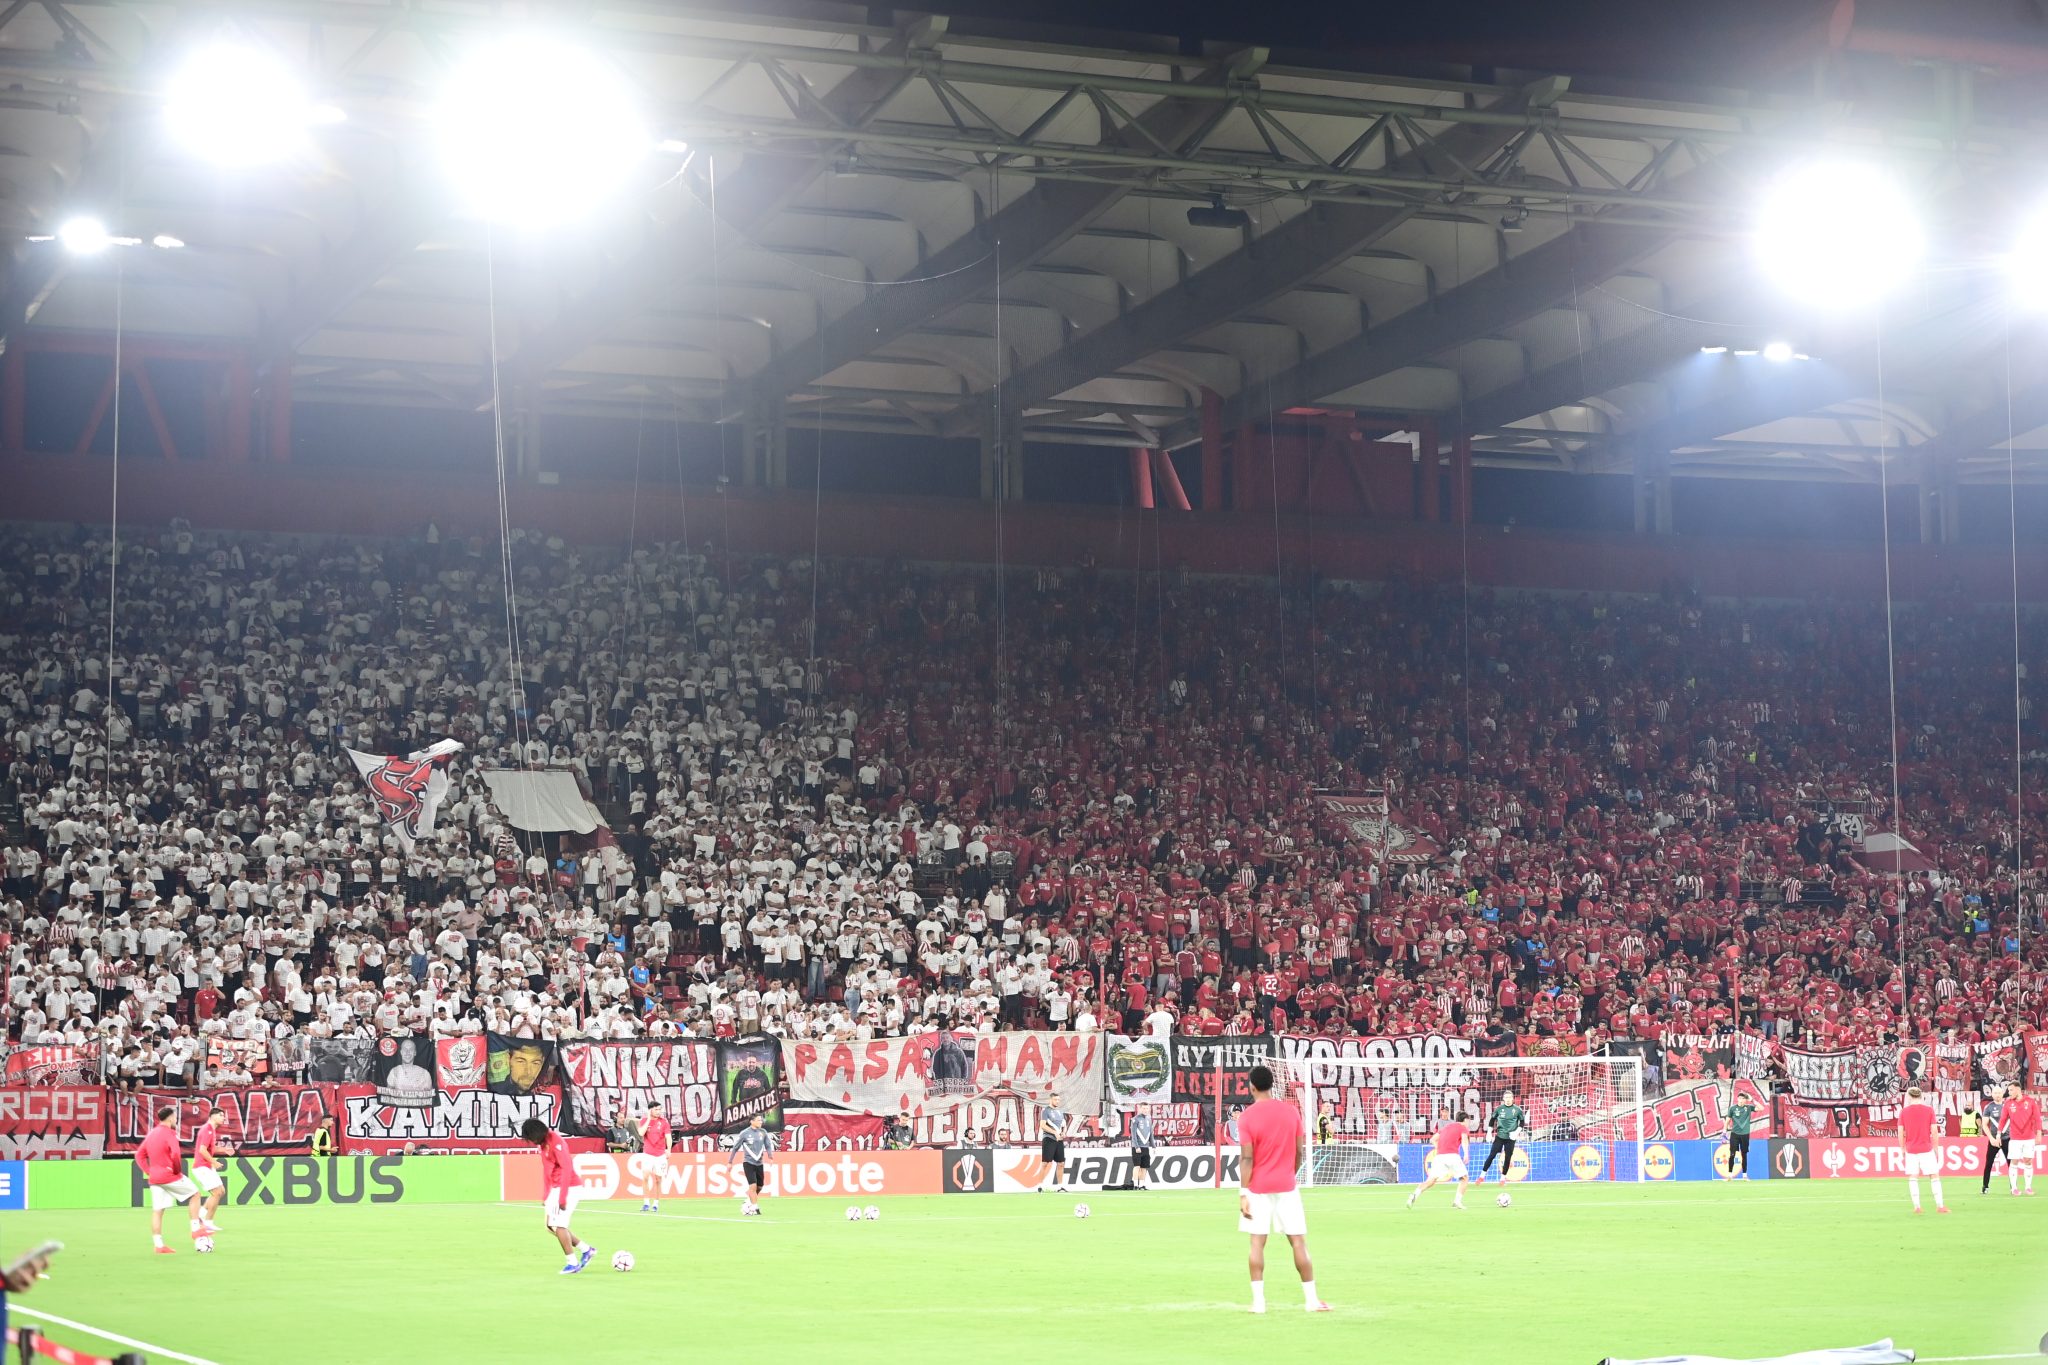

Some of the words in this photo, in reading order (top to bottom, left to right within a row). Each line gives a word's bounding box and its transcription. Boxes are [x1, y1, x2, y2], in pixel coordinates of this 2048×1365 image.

[1264, 978, 1278, 991] 22
[1174, 1070, 1249, 1096] ΑΛΗΤΕ
[570, 1085, 722, 1127] ΝΕΑΠΟ
[1151, 1103, 1198, 1119] ΕΝΙΔΙ
[914, 1098, 1090, 1144] ΕΙΡΑΙΣ
[1716, 1156, 1743, 1165] LiL
[1853, 1145, 1979, 1171] STRUSS
[627, 1154, 885, 1197] Swissquote
